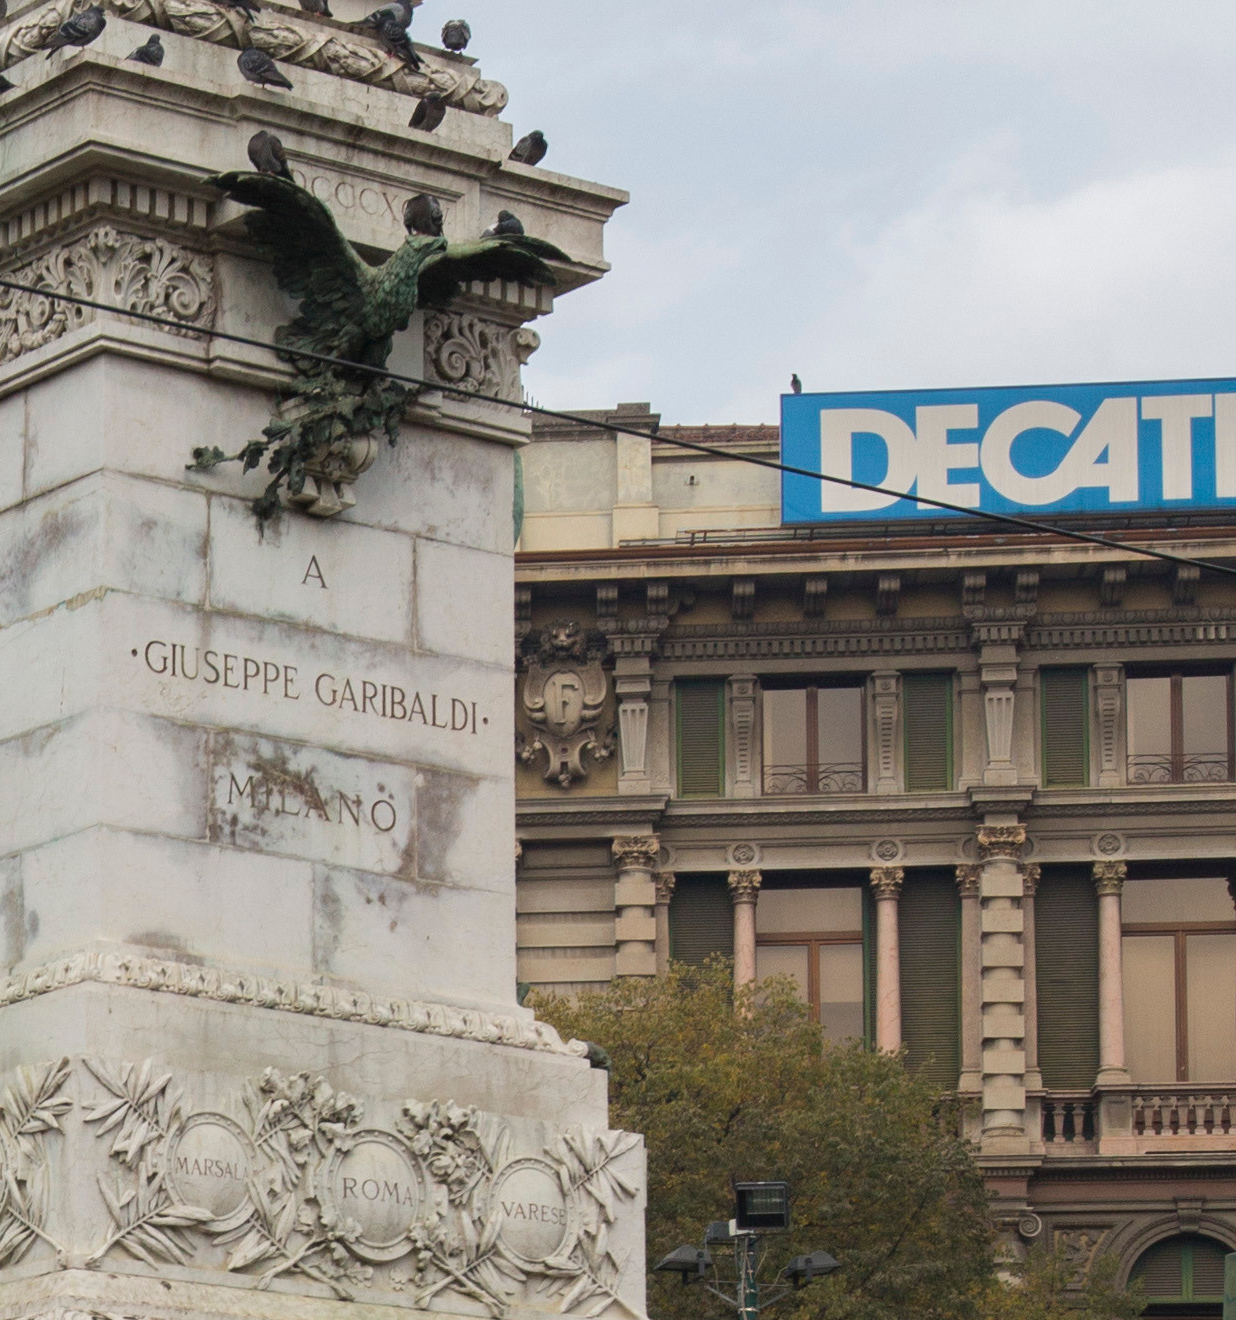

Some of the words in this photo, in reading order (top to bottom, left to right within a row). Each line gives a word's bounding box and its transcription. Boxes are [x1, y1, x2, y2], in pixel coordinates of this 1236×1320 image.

[820, 393, 1236, 513] DECAT
[301, 555, 328, 590] A
[144, 640, 301, 701] GIUSEPPE
[315, 673, 479, 735] GARIBALDI
[227, 772, 397, 832] MILANO
[342, 1177, 413, 1208] ROMA
[500, 1201, 567, 1227] VARESE
